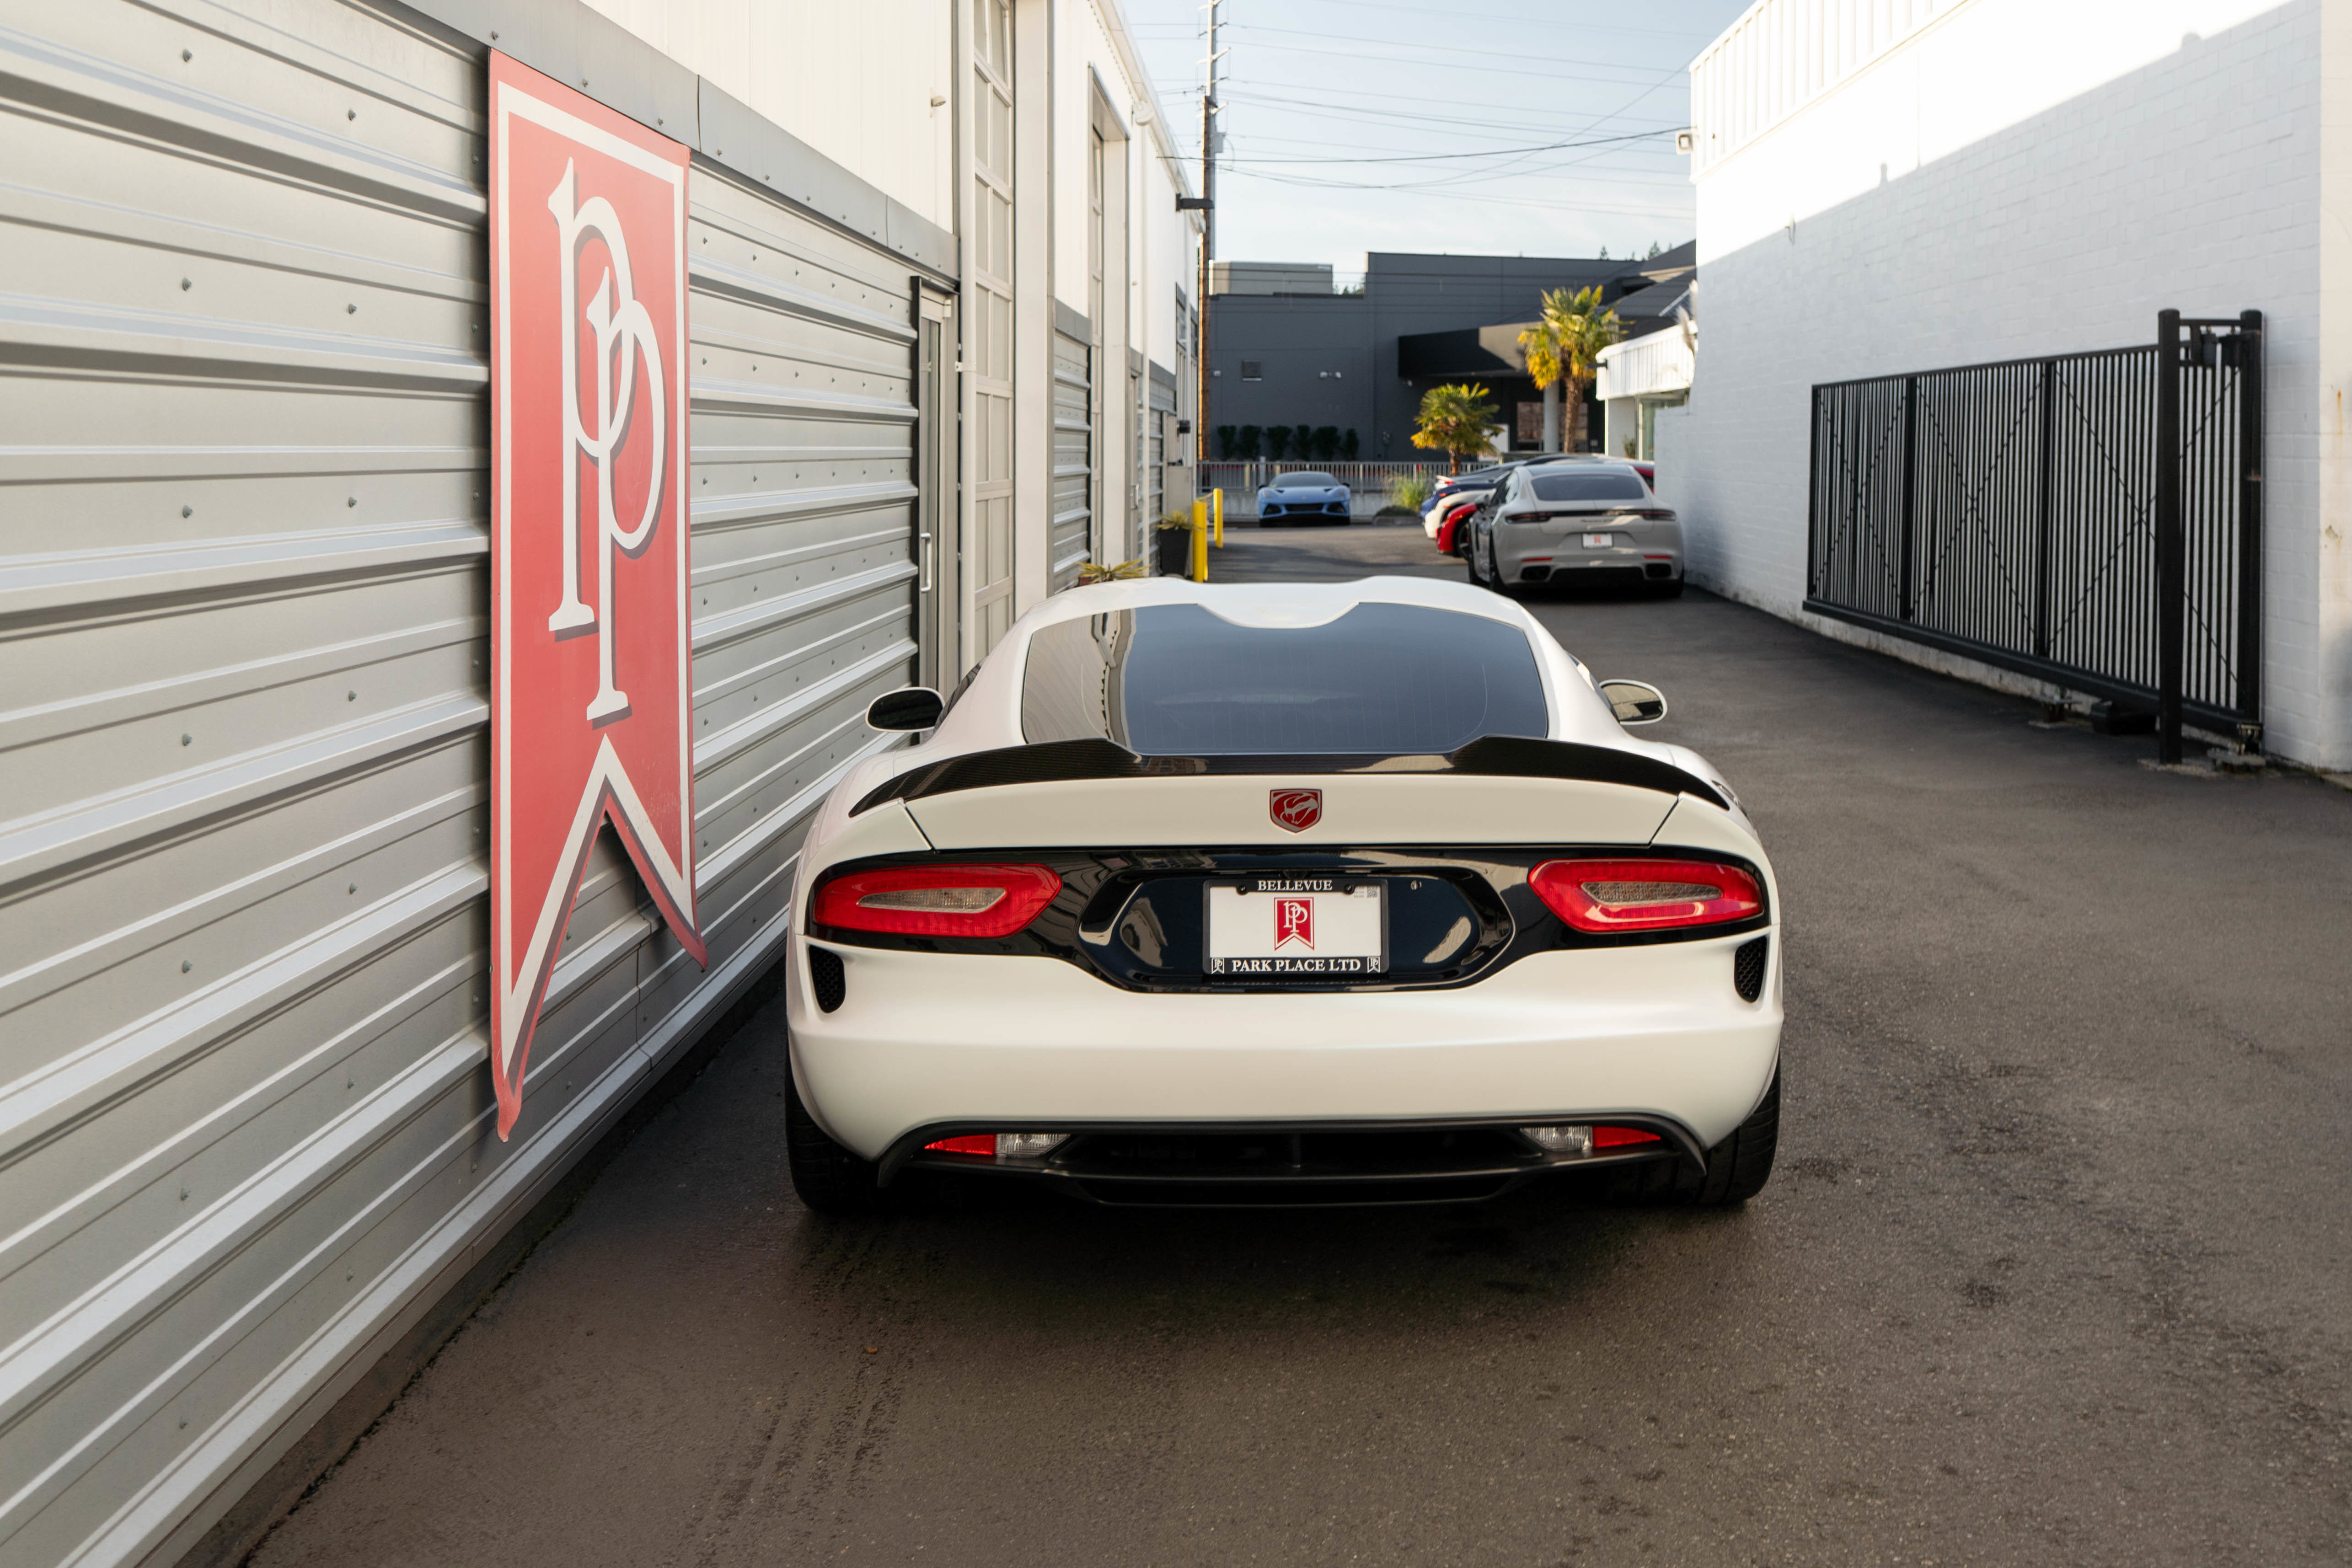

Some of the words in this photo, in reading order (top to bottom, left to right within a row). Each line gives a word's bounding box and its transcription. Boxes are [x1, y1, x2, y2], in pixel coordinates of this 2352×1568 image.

[1257, 880, 1333, 891] BELLEVUE
[1232, 960, 1271, 972] PARK
[1275, 959, 1325, 972] PLACE
[1329, 959, 1361, 971] LTD
